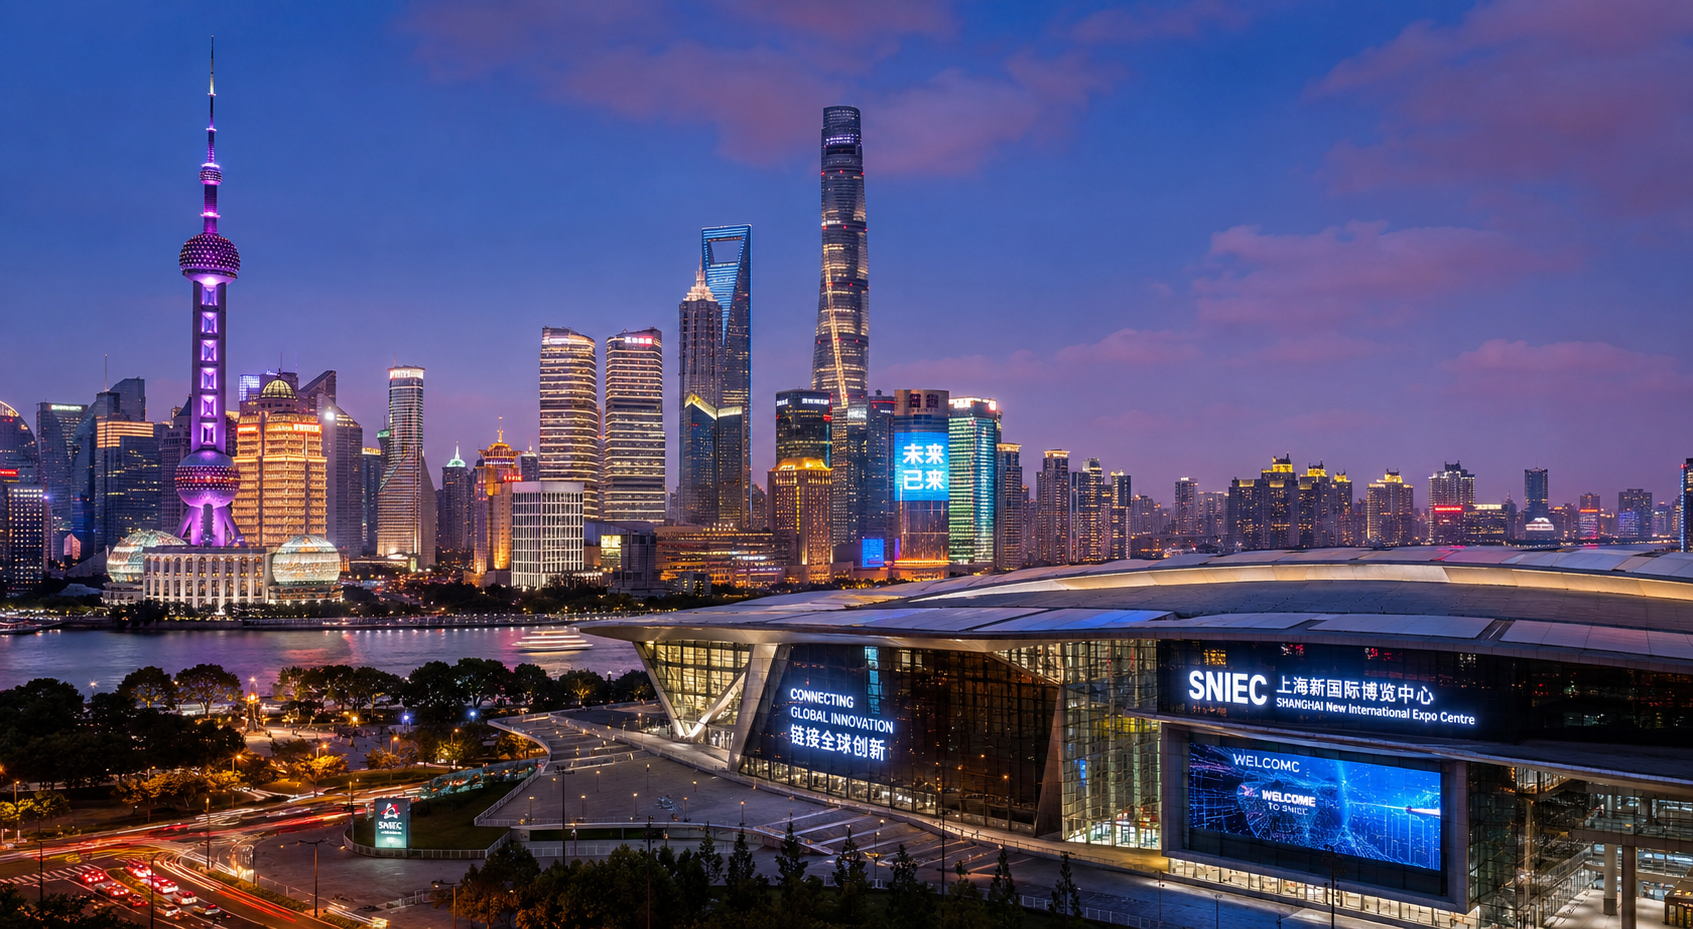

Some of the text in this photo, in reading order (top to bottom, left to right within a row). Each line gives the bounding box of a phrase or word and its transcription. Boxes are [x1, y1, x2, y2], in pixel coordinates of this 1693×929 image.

[902, 443, 945, 465] 未来
[902, 468, 945, 490] 已来
[790, 688, 854, 708] CONNECTING
[1188, 670, 1268, 706] SNIEC
[1276, 675, 1434, 705] 上海新国际博览中心
[790, 706, 894, 734] GLOBAL INNOVATION
[1276, 697, 1476, 725] SHANGHAI New International Expo Centre
[790, 723, 886, 761] 链接全球创新
[1261, 789, 1316, 807] WELCOME
[1268, 802, 1280, 811] TO
